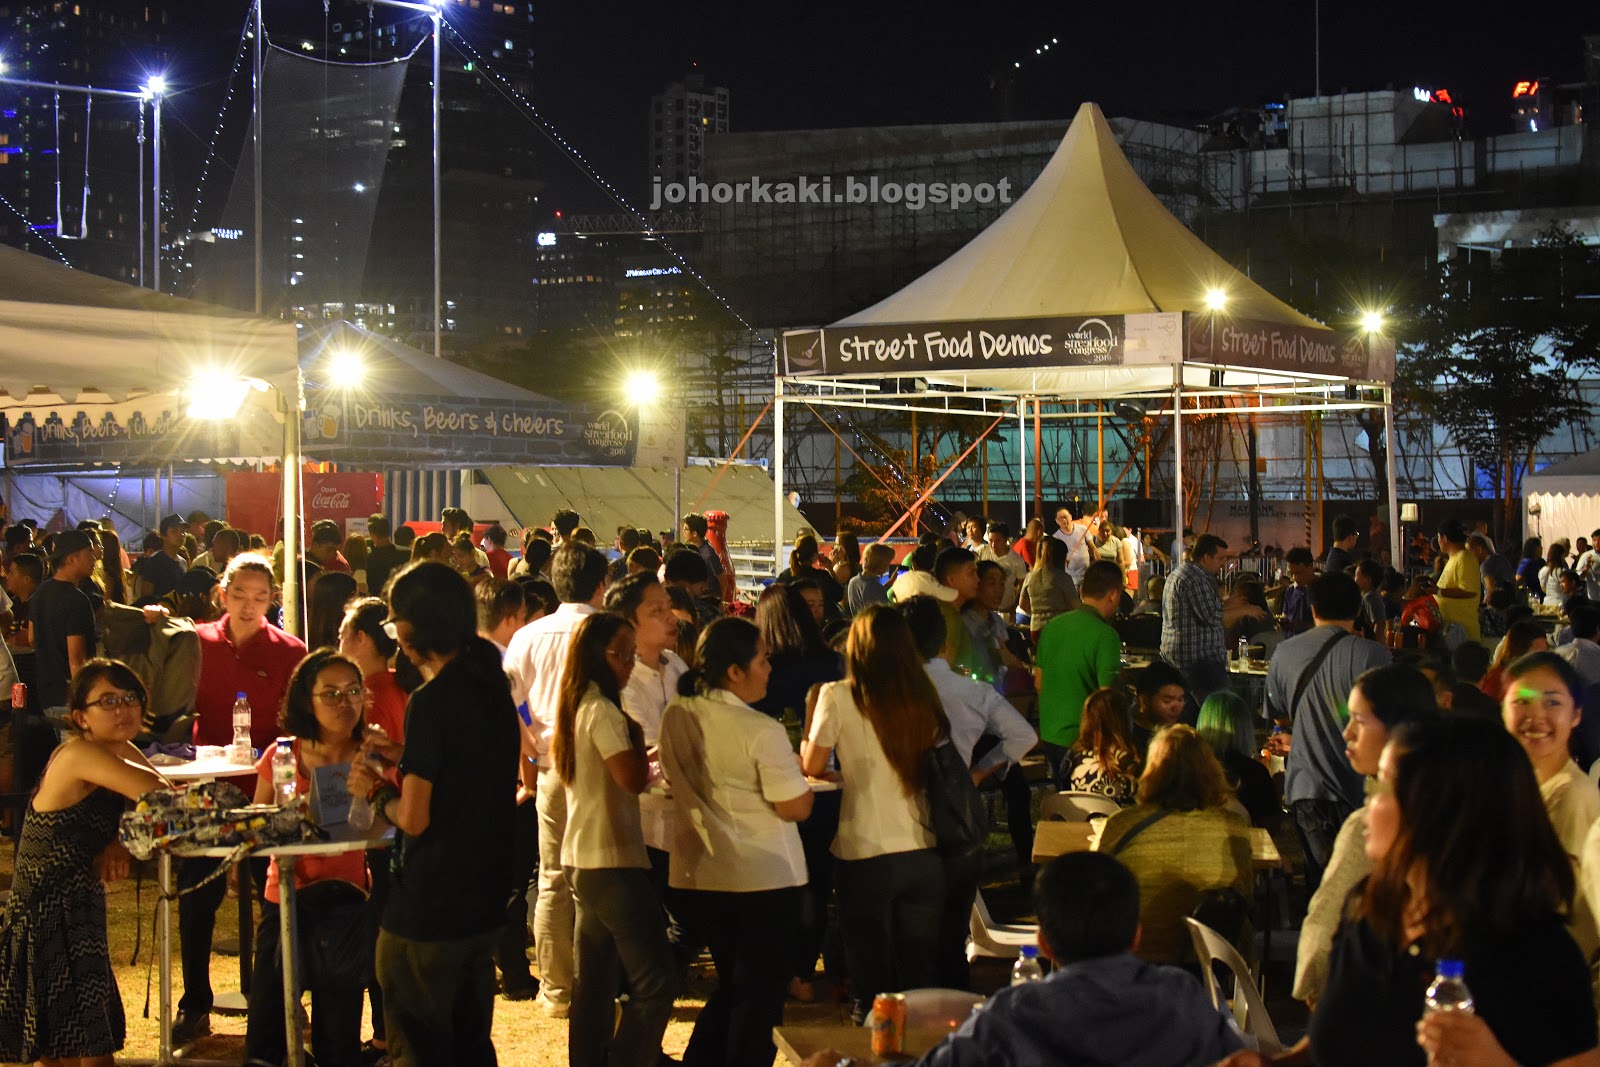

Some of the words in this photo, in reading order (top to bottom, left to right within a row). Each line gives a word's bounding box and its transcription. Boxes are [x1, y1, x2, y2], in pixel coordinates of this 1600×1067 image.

[1067, 330, 1092, 340] world
[923, 330, 973, 362] Food
[979, 330, 1053, 359] Demos
[1069, 346, 1108, 356] congress
[1270, 332, 1297, 362] Food
[1300, 336, 1336, 364] Demos
[354, 403, 418, 438] Drinks,
[423, 405, 479, 431] Beers
[587, 421, 610, 431] world
[587, 439, 623, 448] congress
[321, 486, 337, 494] Open
